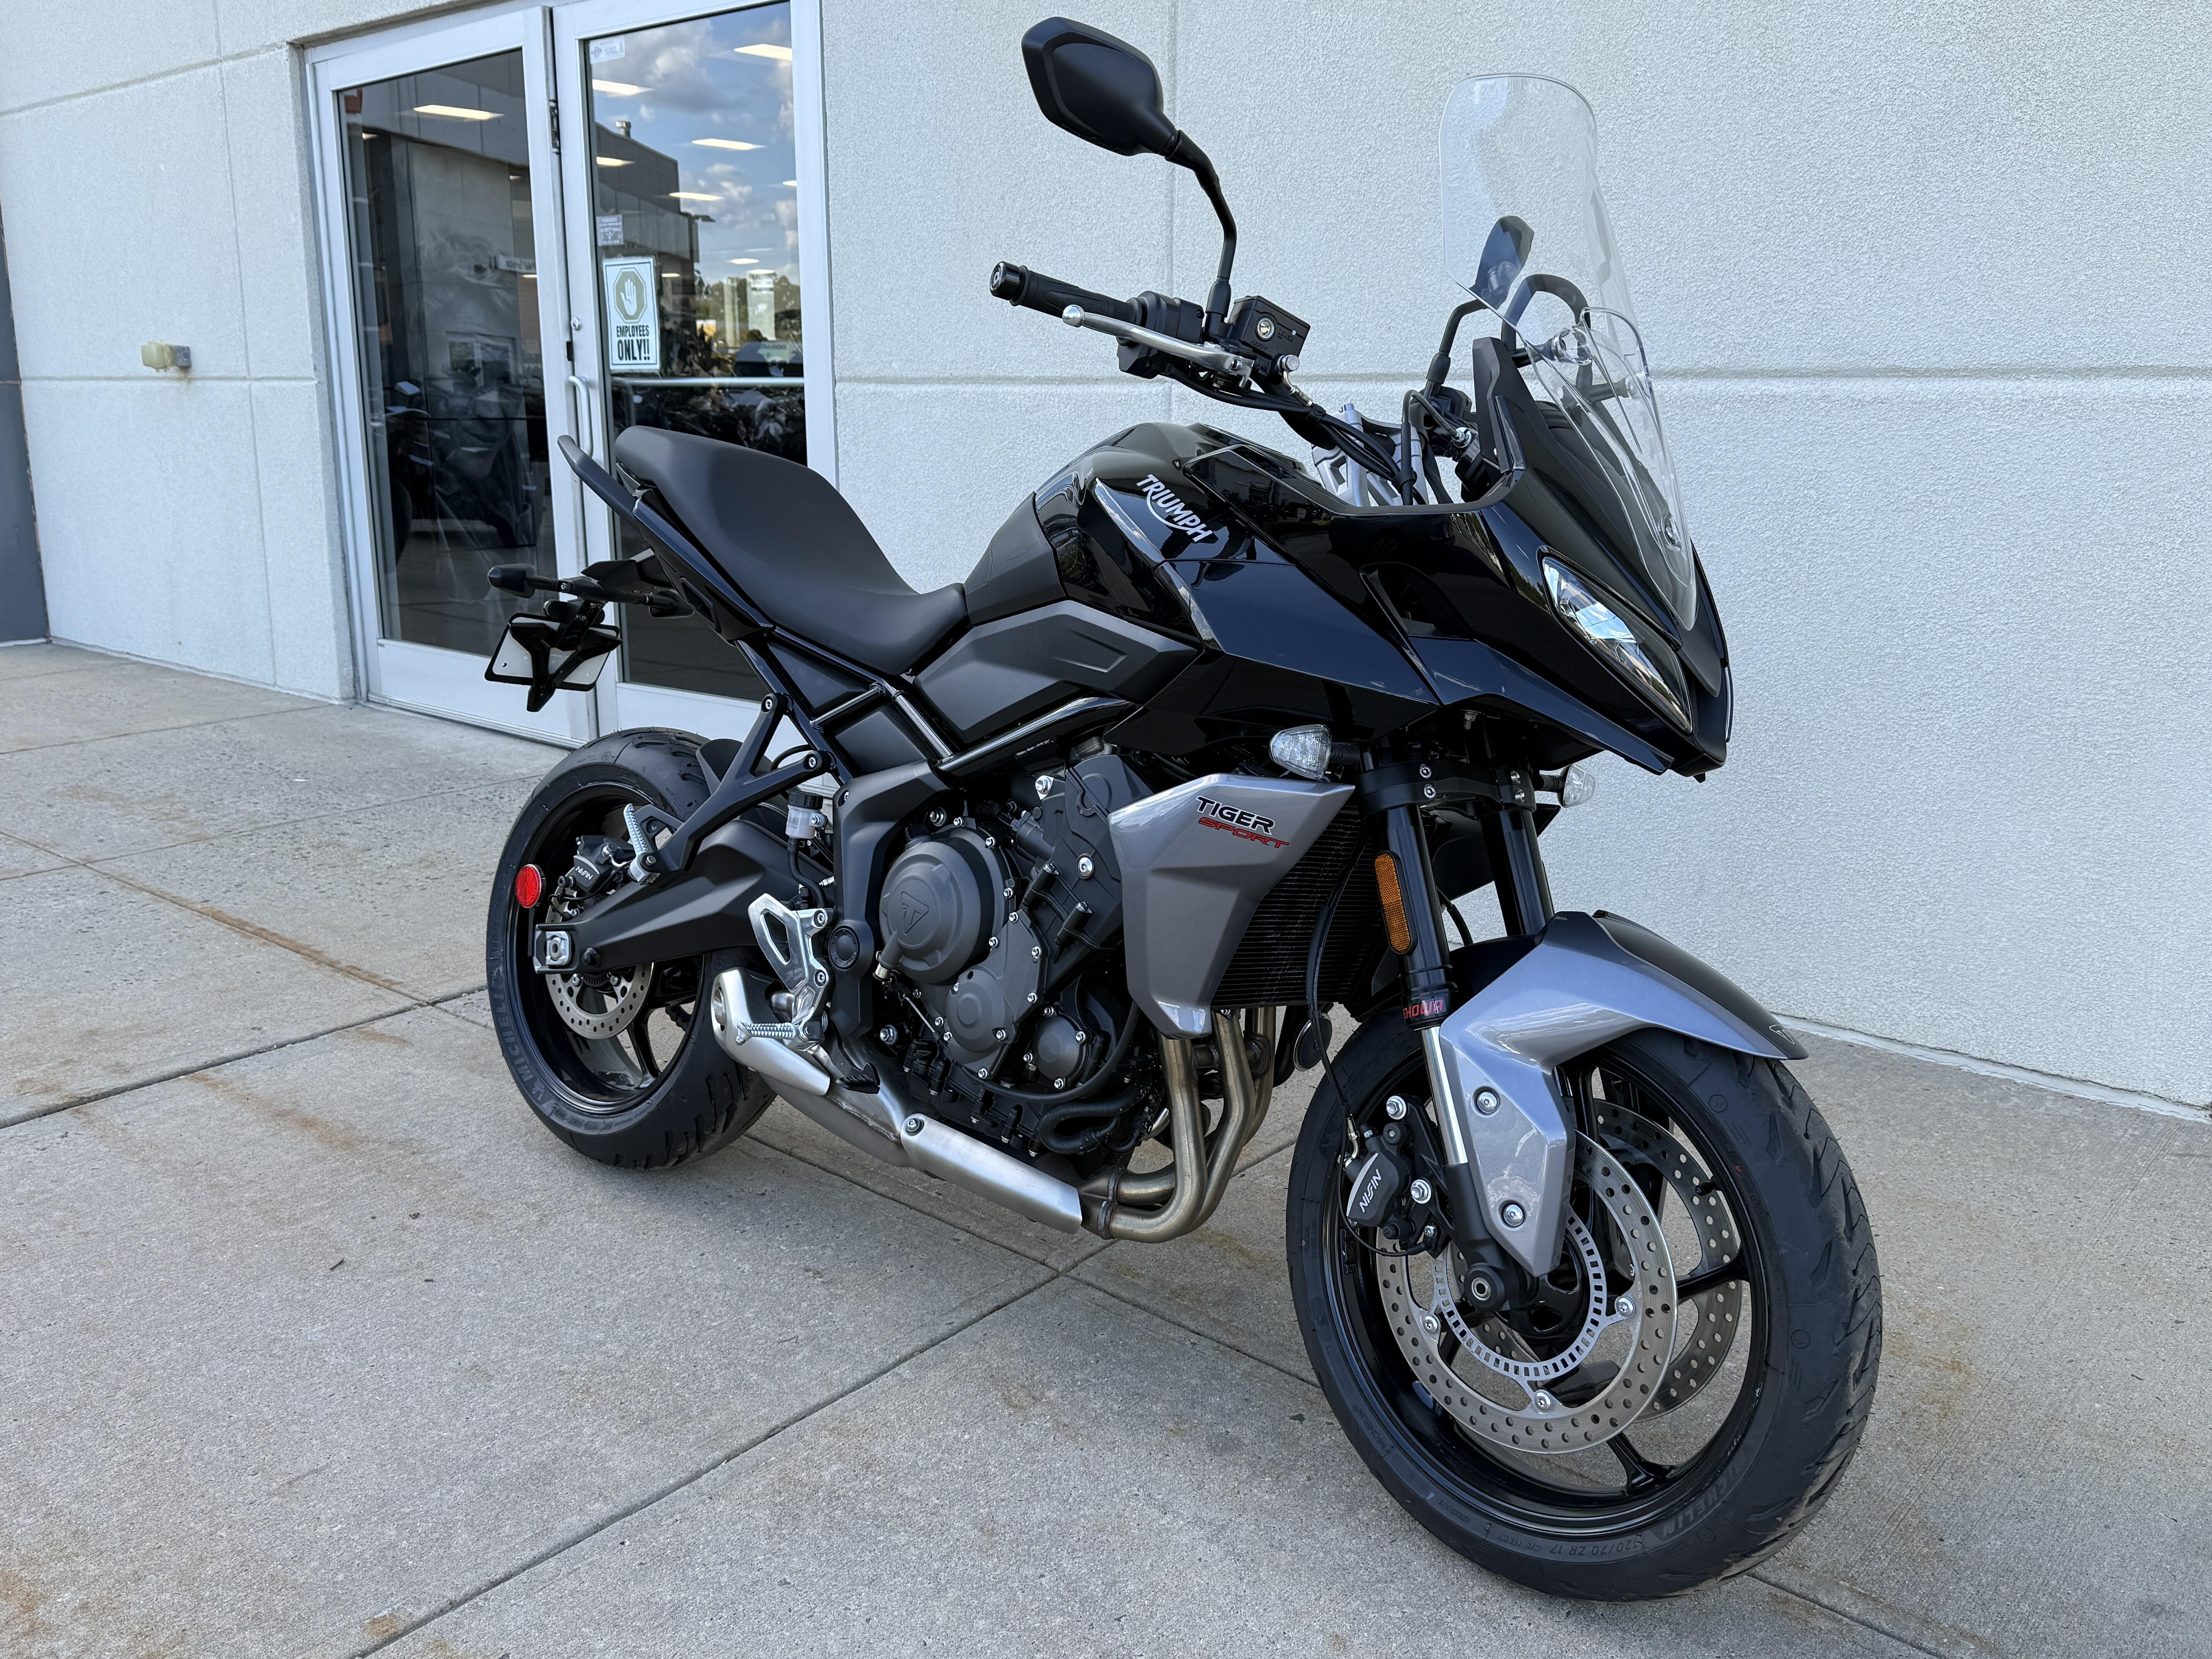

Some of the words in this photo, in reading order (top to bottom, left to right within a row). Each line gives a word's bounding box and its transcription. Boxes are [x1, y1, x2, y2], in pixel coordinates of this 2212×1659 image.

[616, 325, 649, 337] EMPLOYEES
[618, 338, 650, 361] ONLY!!
[1136, 474, 1214, 542] TRIUMPH
[1196, 796, 1275, 835] TIGER
[1198, 816, 1290, 848] SPORT
[575, 865, 593, 880] NISSIN
[493, 977, 533, 1082] MICHELIN
[1359, 1168, 1382, 1213] NISSIN
[1357, 1409, 1387, 1449] MICHELIN
[1663, 1451, 1747, 1537] MICHELIN
[1548, 1544, 1563, 1555] 17
[1568, 1545, 1587, 1556] ZR
[1591, 1539, 1638, 1555] 120/70
